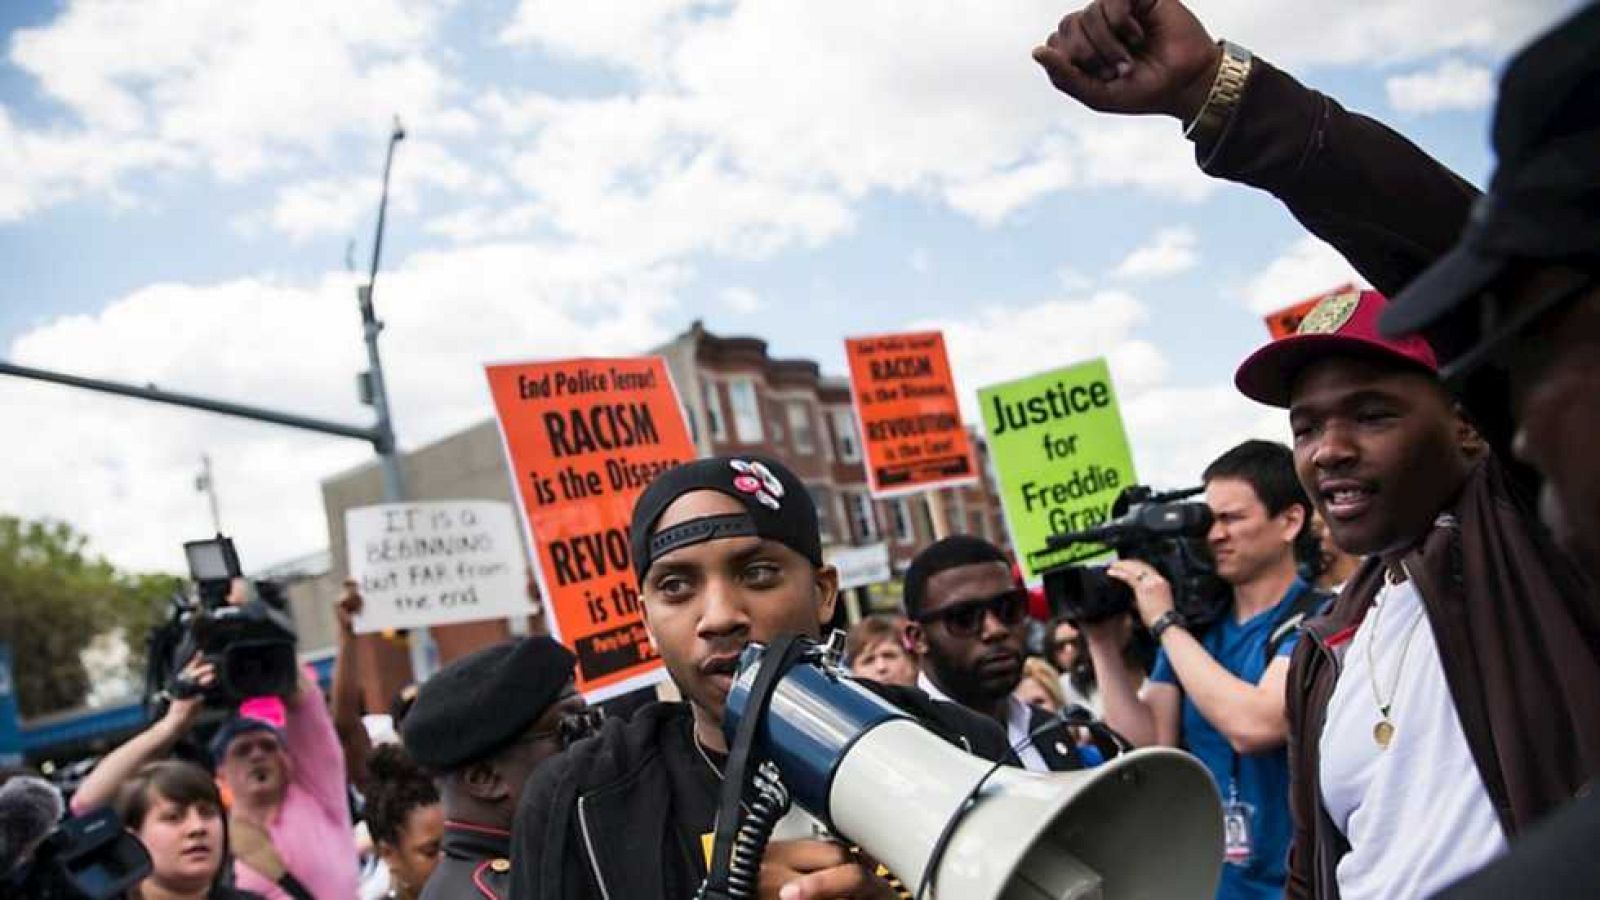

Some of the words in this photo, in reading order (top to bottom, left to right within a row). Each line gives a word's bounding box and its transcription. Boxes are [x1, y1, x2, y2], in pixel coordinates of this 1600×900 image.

[518, 373, 551, 400] End
[555, 367, 606, 396] Police
[869, 355, 933, 382] RACISM
[993, 380, 1110, 436] Justice
[543, 402, 660, 458] RACISM
[866, 412, 958, 441] REVOLUTION
[1042, 432, 1078, 462] for
[529, 470, 556, 506] is
[558, 464, 603, 501] the
[1021, 464, 1120, 513] Freddie
[383, 509, 418, 533] IT
[366, 532, 494, 563] BEGINNING
[548, 525, 632, 587] REVO
[408, 563, 447, 586] FAR
[456, 560, 509, 580] from
[439, 587, 479, 607] end
[583, 590, 608, 625] is
